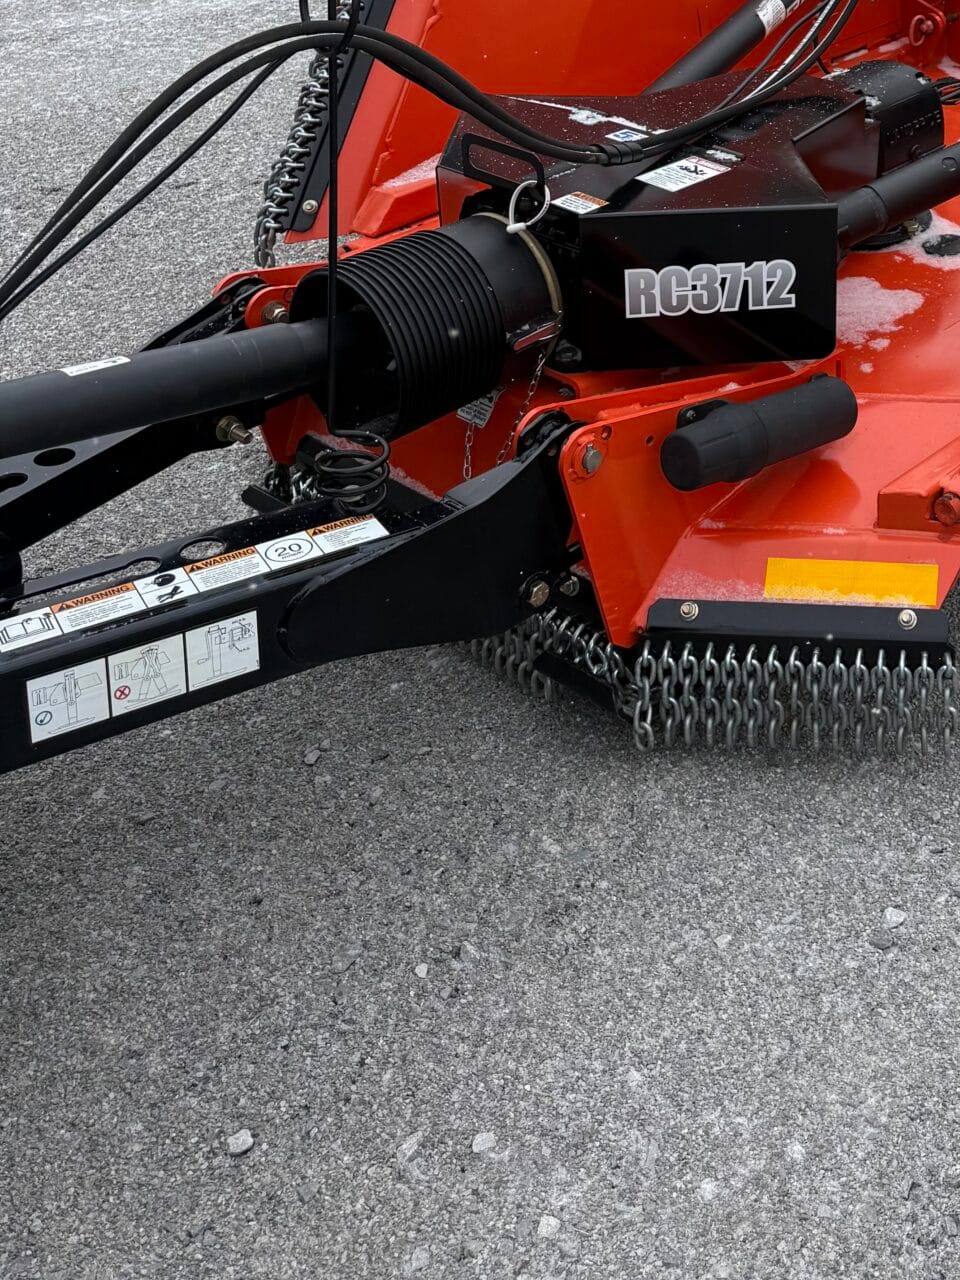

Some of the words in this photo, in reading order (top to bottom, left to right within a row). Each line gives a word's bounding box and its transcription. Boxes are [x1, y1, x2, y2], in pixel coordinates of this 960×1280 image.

[624, 258, 797, 319] RC3712
[322, 514, 374, 534] WARNING
[202, 548, 257, 569] WARNING
[274, 542, 303, 558] 20
[72, 583, 131, 609] WARNING
